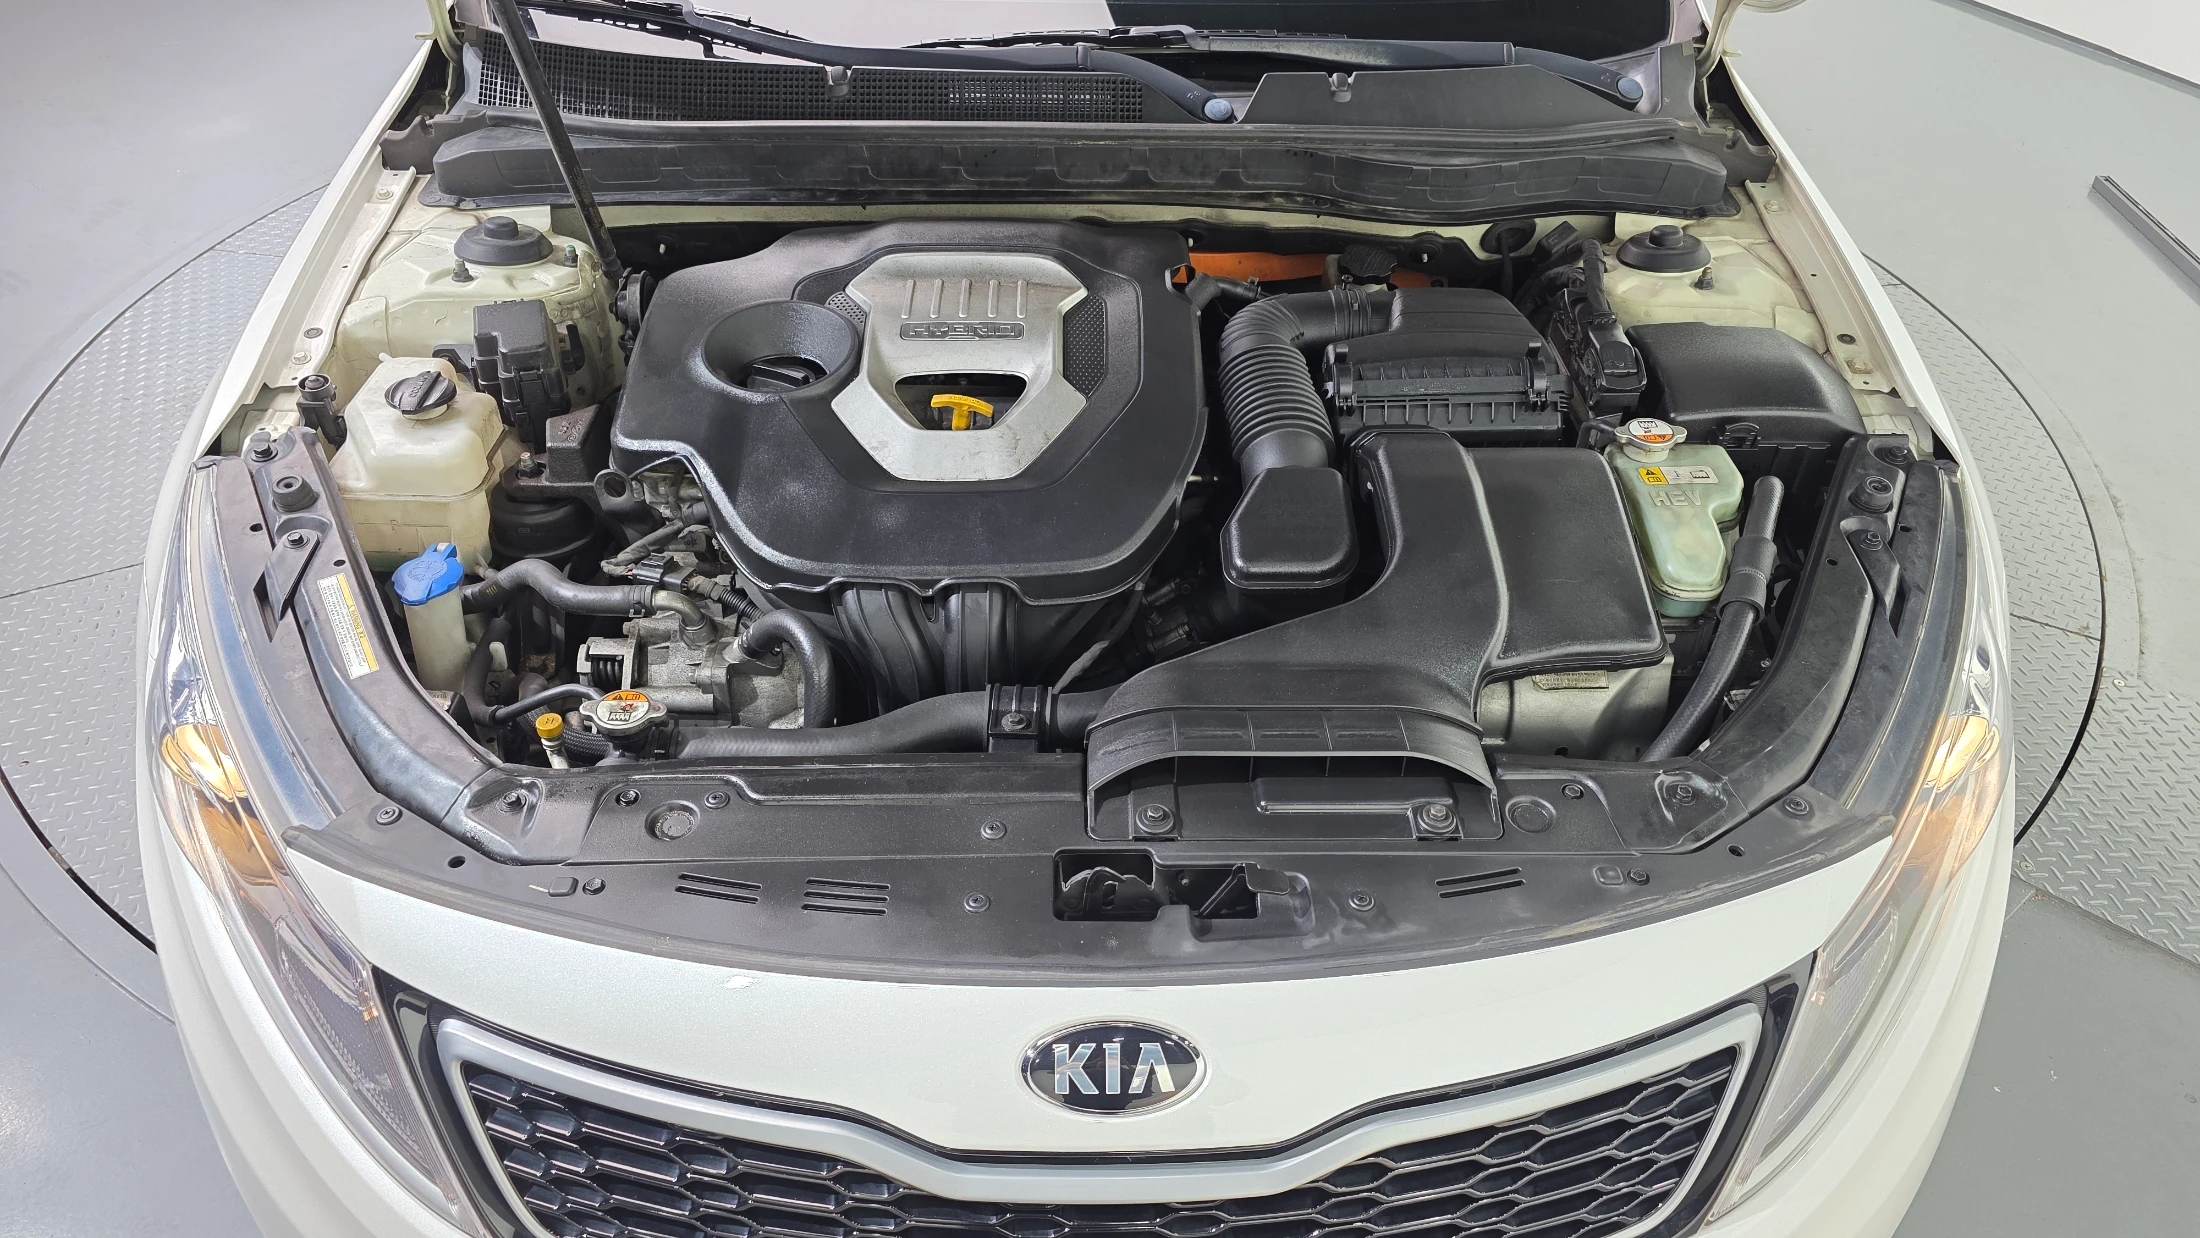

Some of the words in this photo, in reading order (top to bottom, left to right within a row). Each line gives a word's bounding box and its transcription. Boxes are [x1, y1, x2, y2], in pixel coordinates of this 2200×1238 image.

[908, 324, 1015, 336] HYBRID
[1648, 490, 1702, 506] HEV
[1052, 1043, 1176, 1095] KIA
